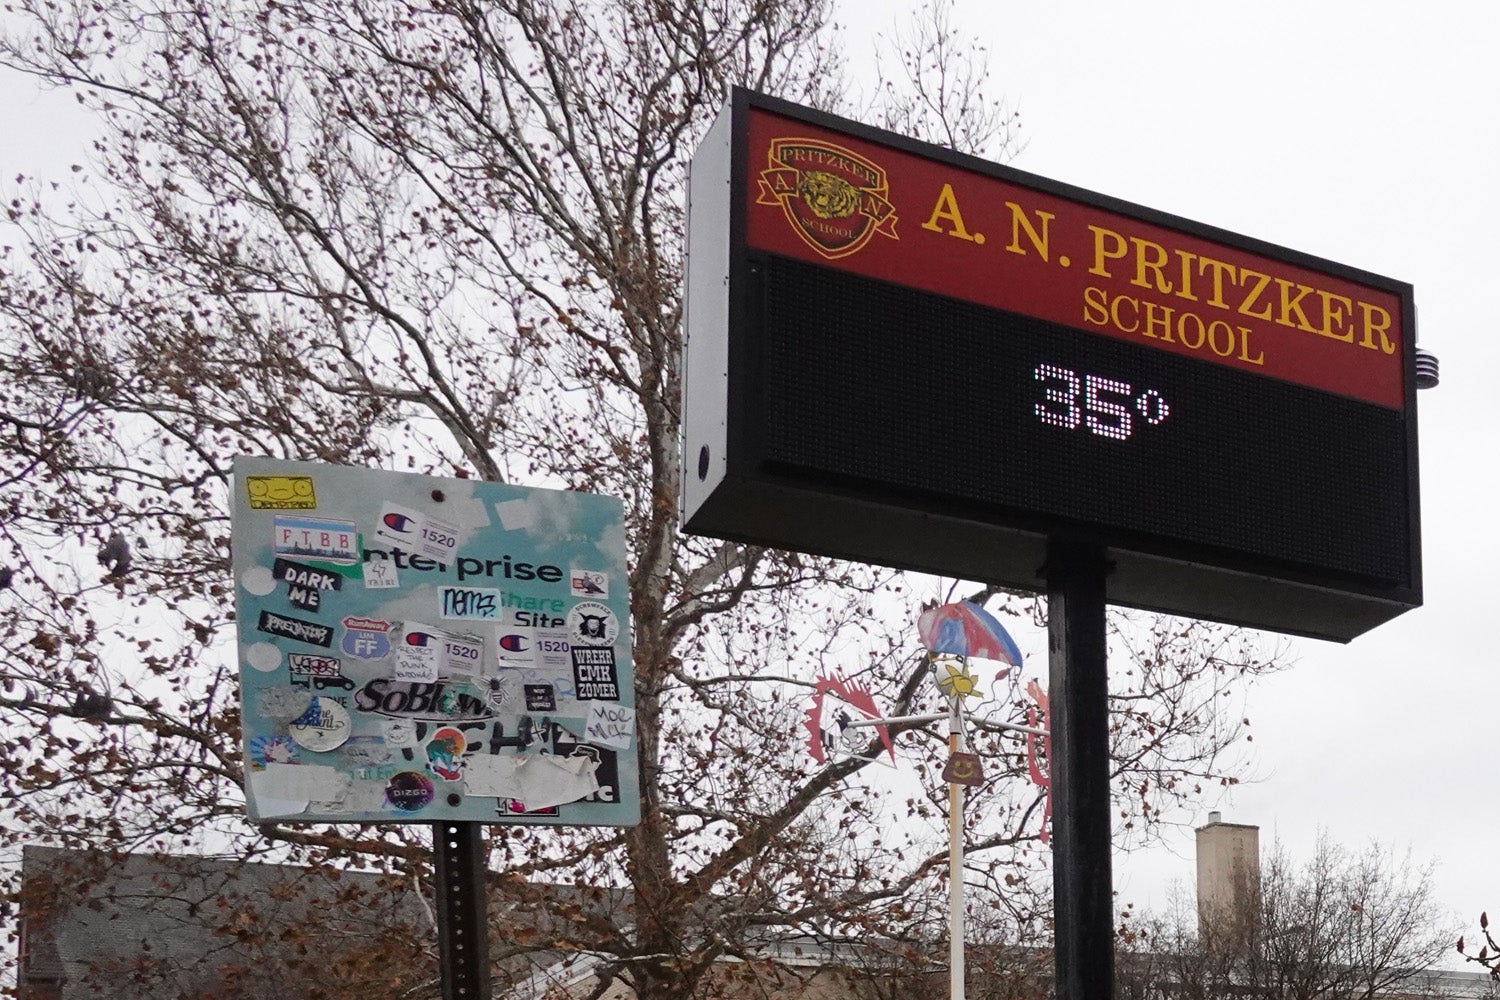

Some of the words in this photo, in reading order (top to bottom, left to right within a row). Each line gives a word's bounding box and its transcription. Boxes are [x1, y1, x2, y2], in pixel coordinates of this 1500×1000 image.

[782, 149, 877, 187] PRITZKER
[774, 173, 795, 191] A.
[864, 196, 884, 219] N.
[801, 217, 857, 239] SCHOOL
[922, 183, 986, 245] A.
[1005, 201, 1071, 268] N.
[1087, 224, 1396, 355] PRITZKER
[1083, 286, 1265, 366] SCHOOL
[422, 528, 456, 548] 1520
[285, 567, 336, 592] DARK
[289, 586, 319, 606] ME
[354, 640, 378, 655] FF
[445, 643, 479, 660] 1520
[537, 641, 569, 653] 1520
[578, 683, 617, 698] ZOMER
[394, 789, 428, 797] DIZGO
